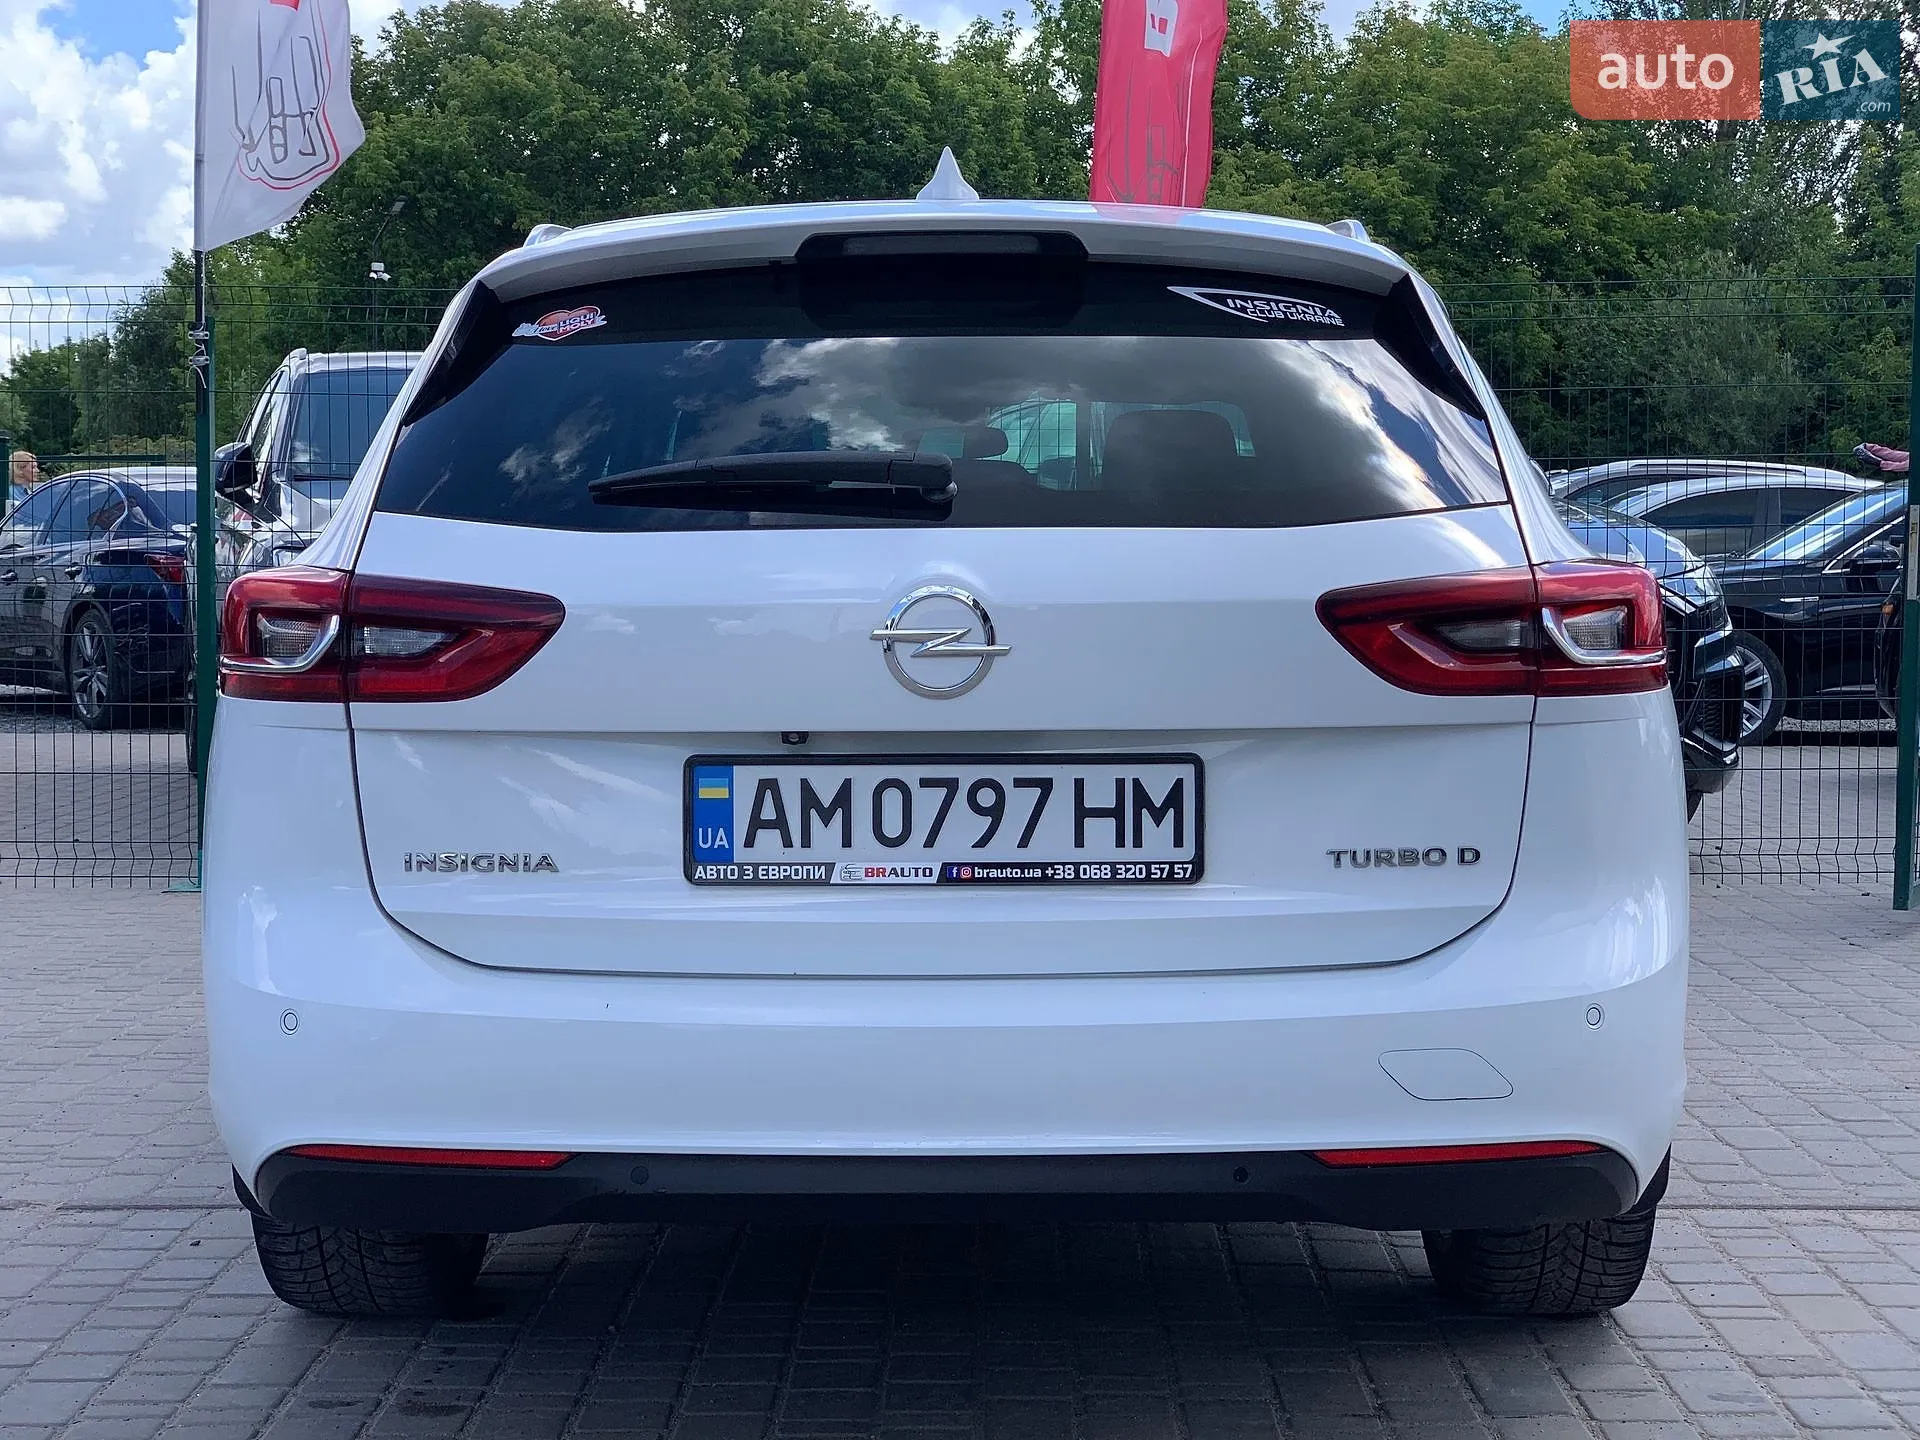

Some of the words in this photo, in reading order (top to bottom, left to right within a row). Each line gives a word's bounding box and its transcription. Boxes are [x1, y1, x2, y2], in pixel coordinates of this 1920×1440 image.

[1227, 298, 1341, 319] INSIGNIA
[1247, 308, 1285, 319] CLUB
[1288, 312, 1345, 327] UKRAINE
[559, 319, 594, 334] MOLY
[560, 312, 597, 326] LIQUI
[743, 777, 852, 848] AM
[871, 777, 1054, 849] 0797
[1073, 777, 1185, 849] HM
[698, 827, 729, 849] UA
[403, 852, 560, 873] INSIGNIA
[1326, 847, 1448, 869] TURBO
[1457, 847, 1481, 866] D
[694, 865, 739, 880] АВТО
[758, 865, 826, 880] ЄВРОПИ
[864, 866, 934, 878] BRAUTO
[974, 866, 1042, 878] brauto.ua
[1045, 864, 1075, 879] +38
[1079, 864, 1111, 879] 068
[1115, 864, 1147, 879] 320
[1150, 864, 1170, 879] 57
[1173, 864, 1193, 879] 57
